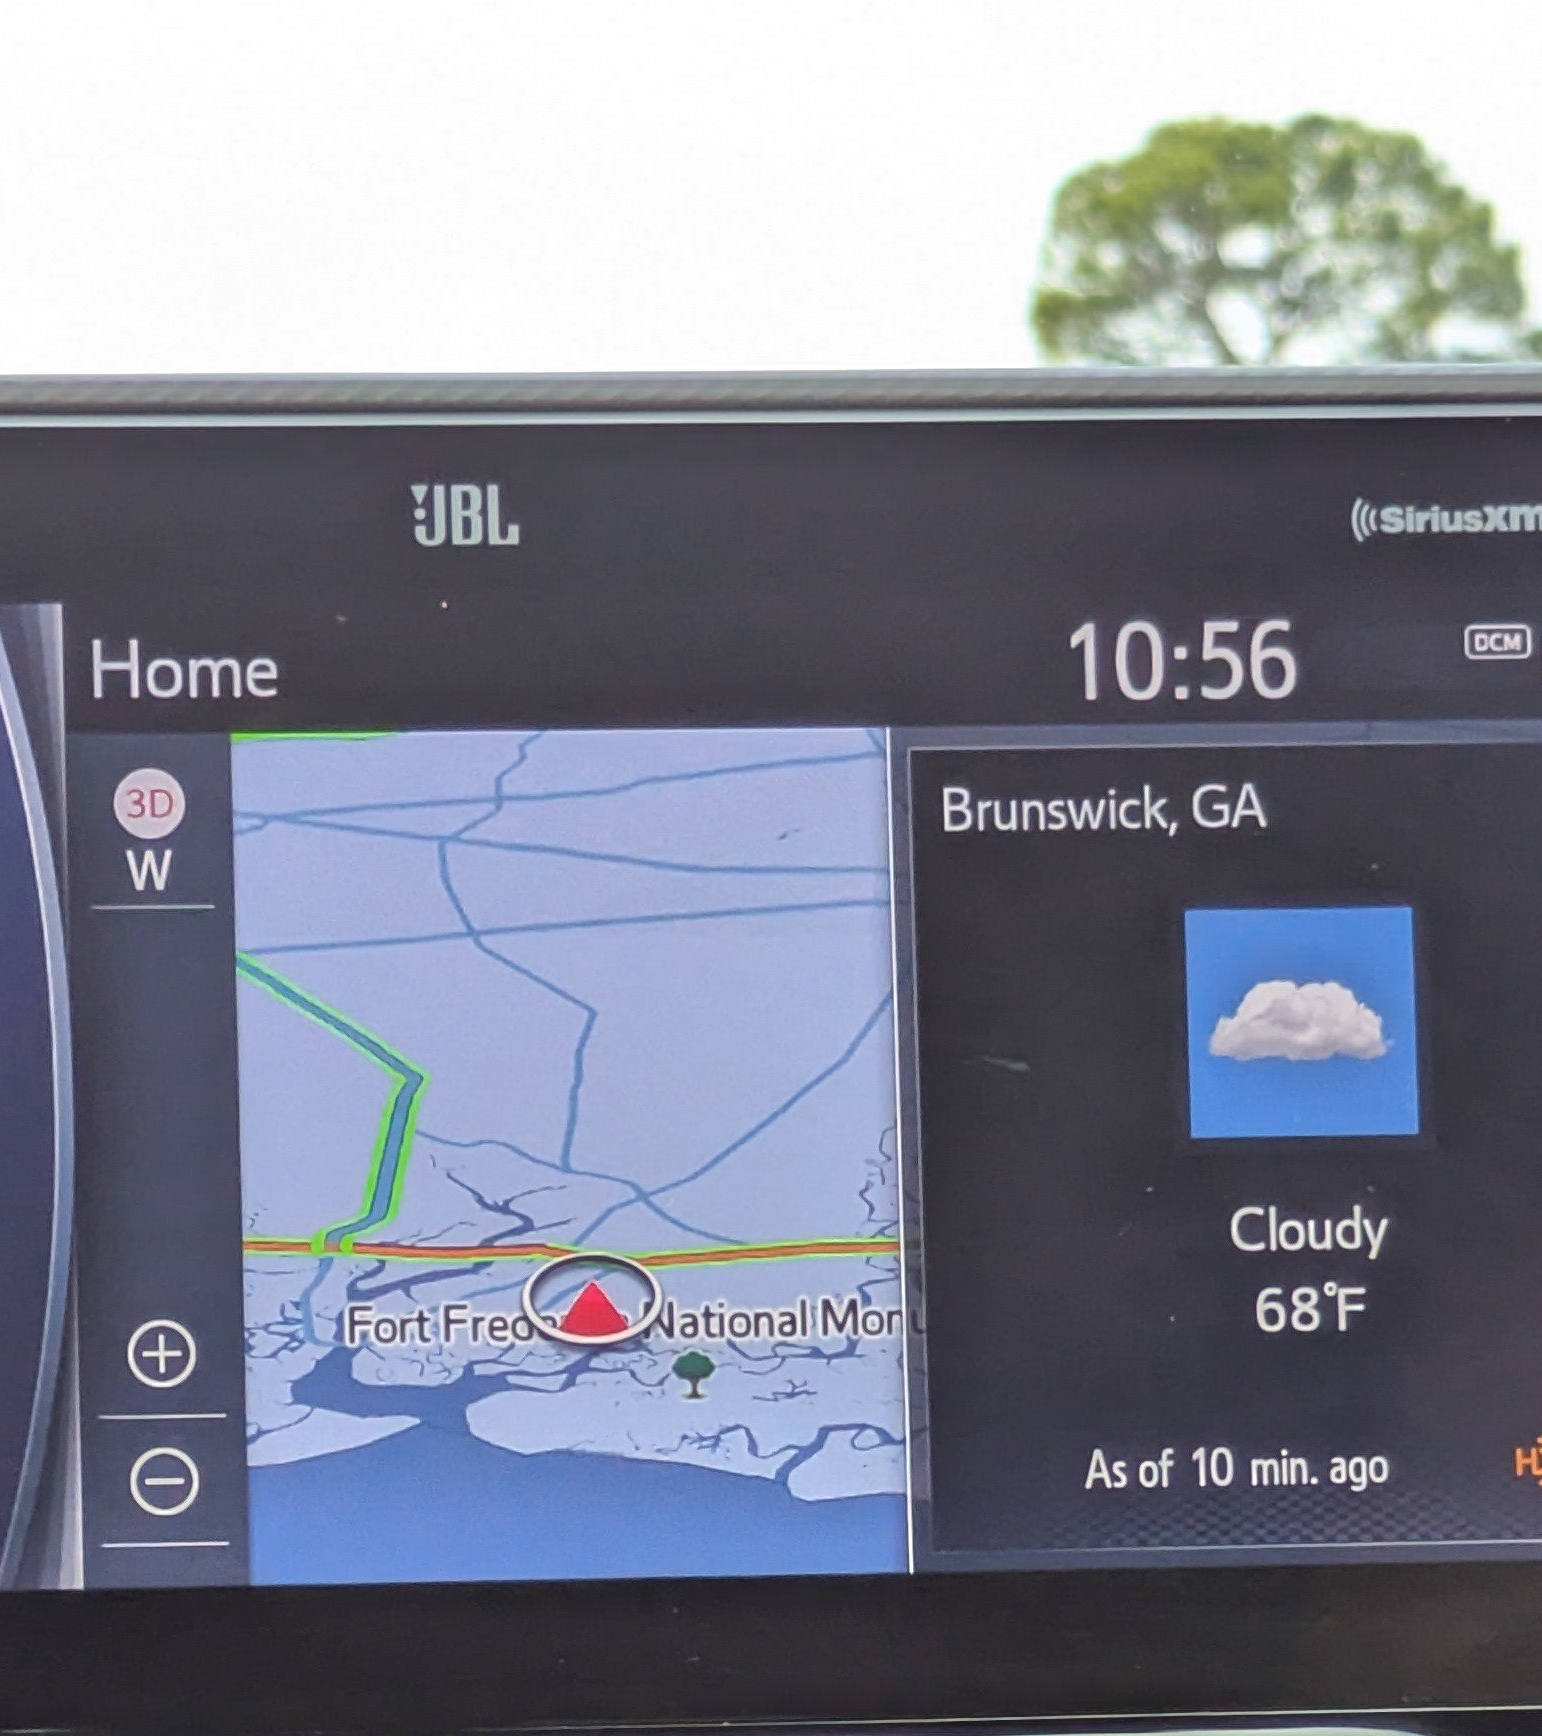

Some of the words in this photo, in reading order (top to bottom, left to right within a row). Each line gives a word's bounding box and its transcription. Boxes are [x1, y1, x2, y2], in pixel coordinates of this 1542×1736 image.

[410, 483, 520, 547] JBL
[1068, 618, 1298, 702] 10:56
[1474, 633, 1521, 652] DCM
[90, 639, 279, 702] Home
[125, 788, 174, 821] 3D
[942, 787, 1179, 838] Brunswick,
[1192, 784, 1268, 830] GA
[126, 850, 173, 891] W
[1229, 1206, 1390, 1260] Cloudy
[347, 1305, 431, 1344] Fort
[643, 1298, 808, 1339] National
[1256, 1281, 1368, 1334] 68°F
[1085, 1450, 1129, 1491] As
[1138, 1448, 1175, 1489] of
[1192, 1448, 1234, 1488] 10
[1250, 1448, 1319, 1487] min.
[1329, 1451, 1389, 1492] ago
